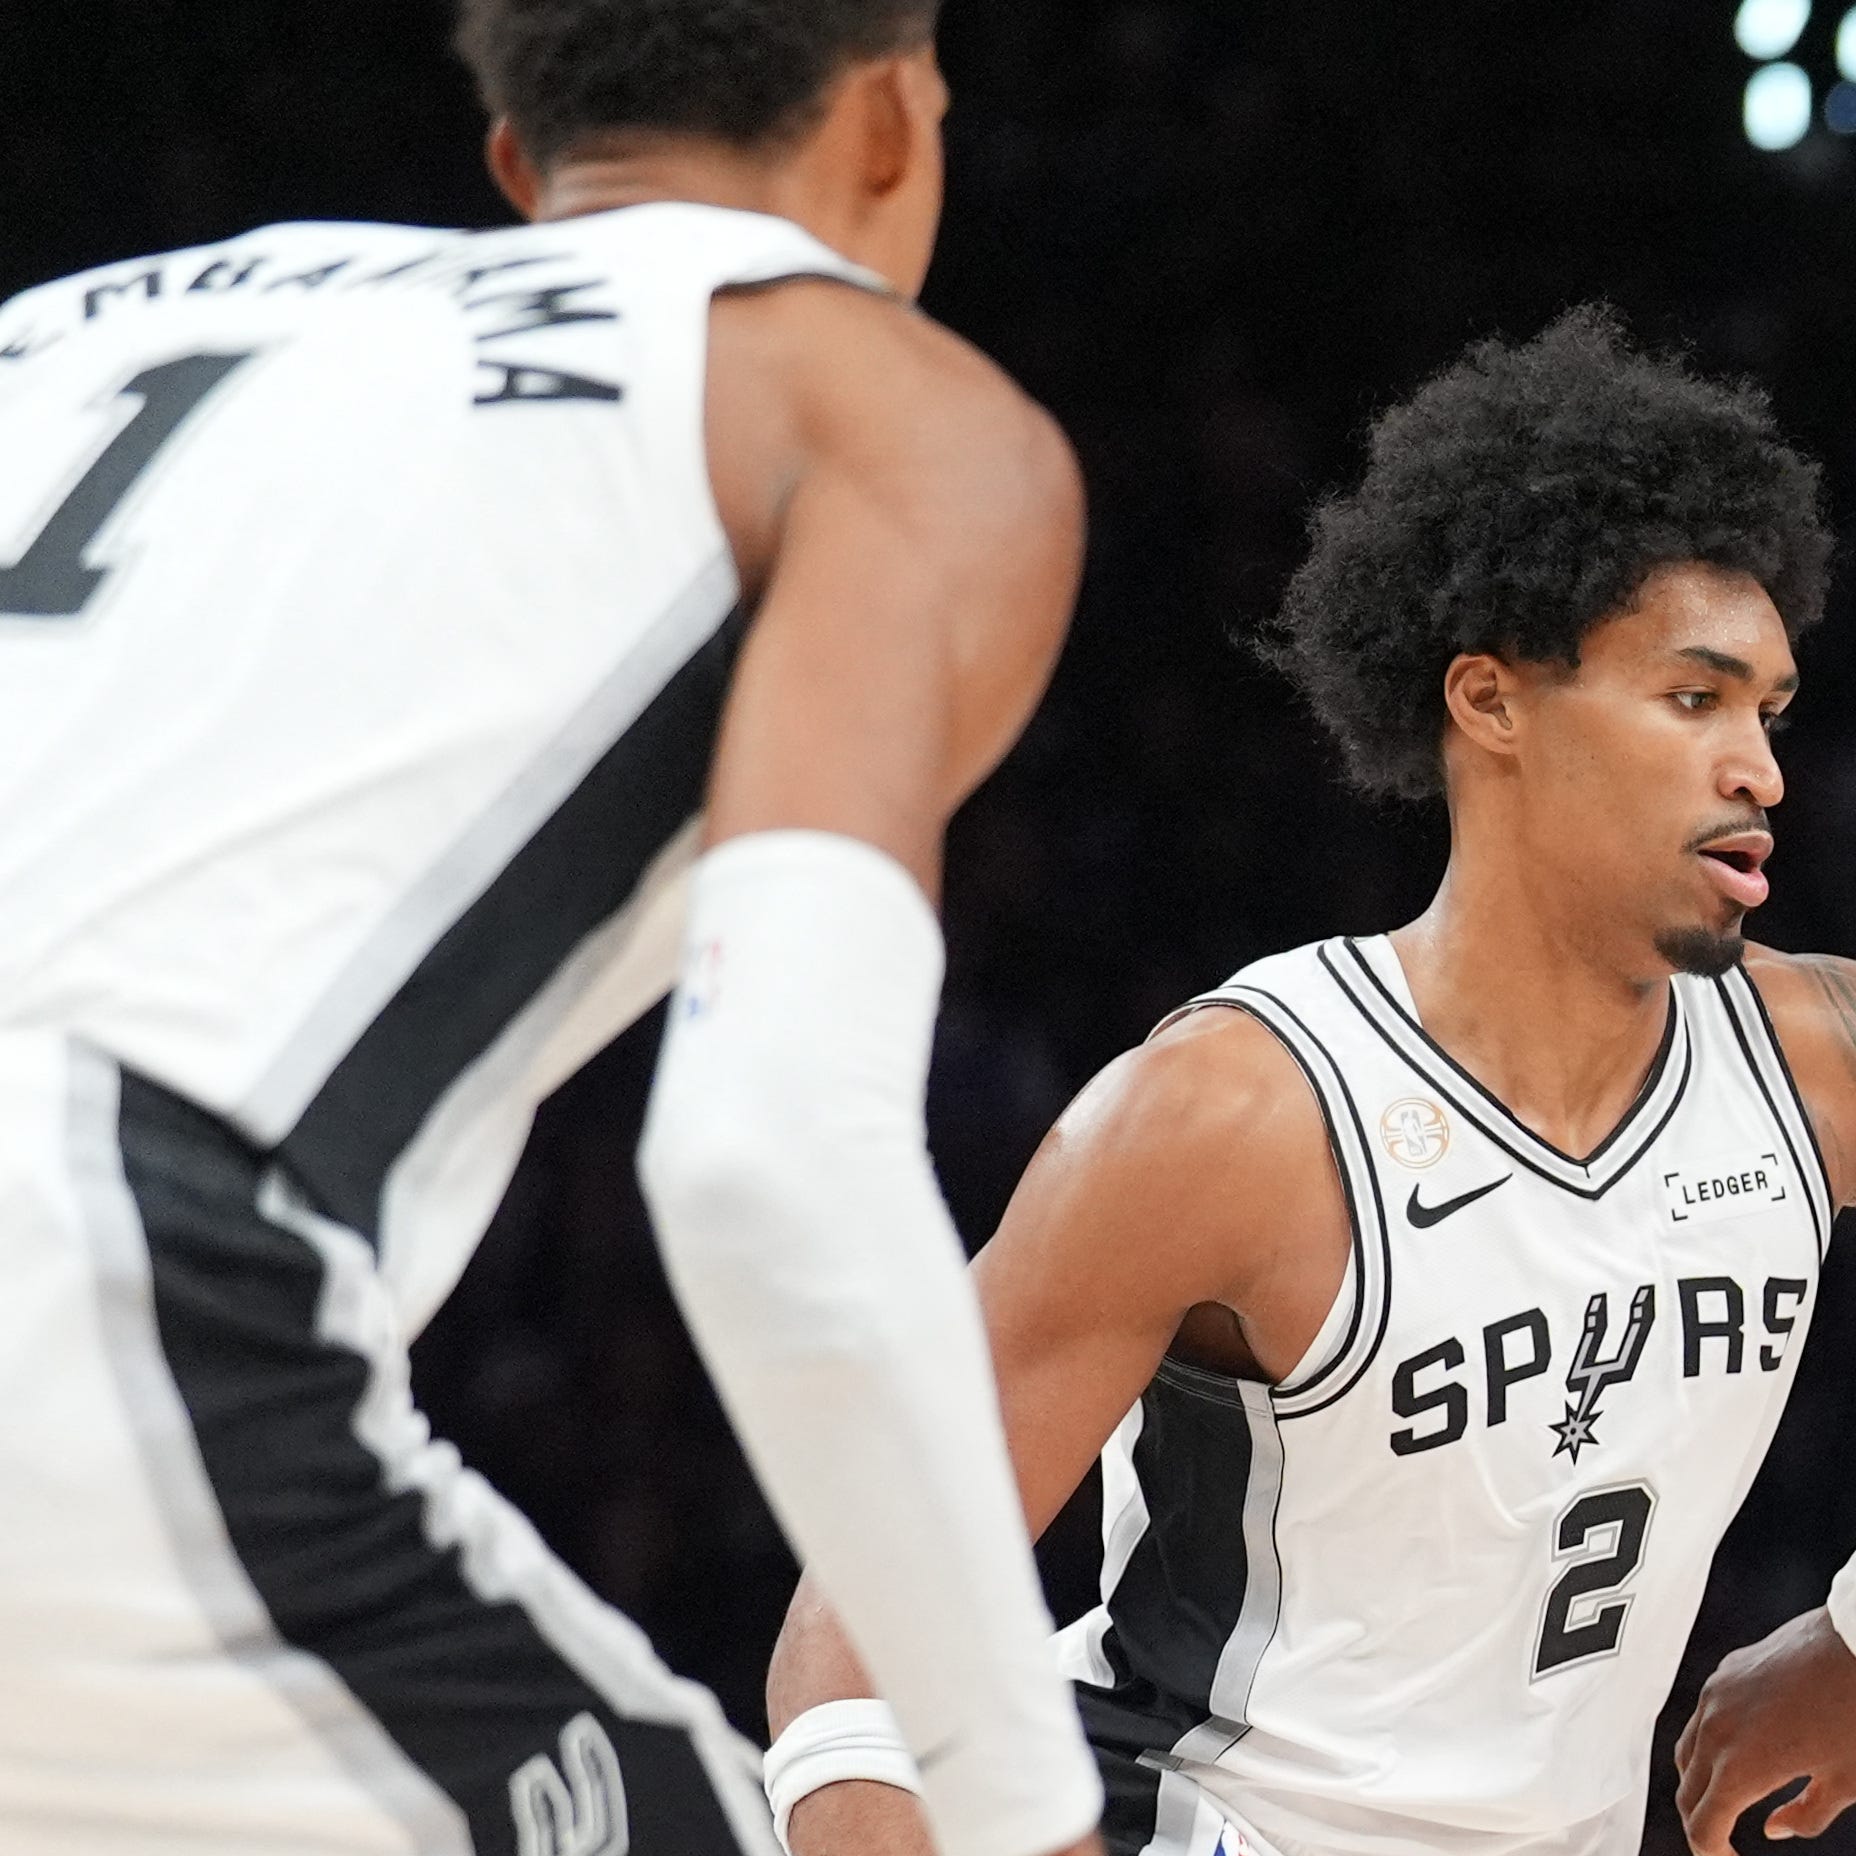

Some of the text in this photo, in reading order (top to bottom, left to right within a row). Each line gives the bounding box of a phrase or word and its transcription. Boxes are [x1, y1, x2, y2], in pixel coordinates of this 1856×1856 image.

[0, 350, 255, 616] 1
[1682, 1171, 1769, 1204] LEDGER
[1391, 1276, 1808, 1465] SPURS
[1530, 1478, 1660, 1686] 2
